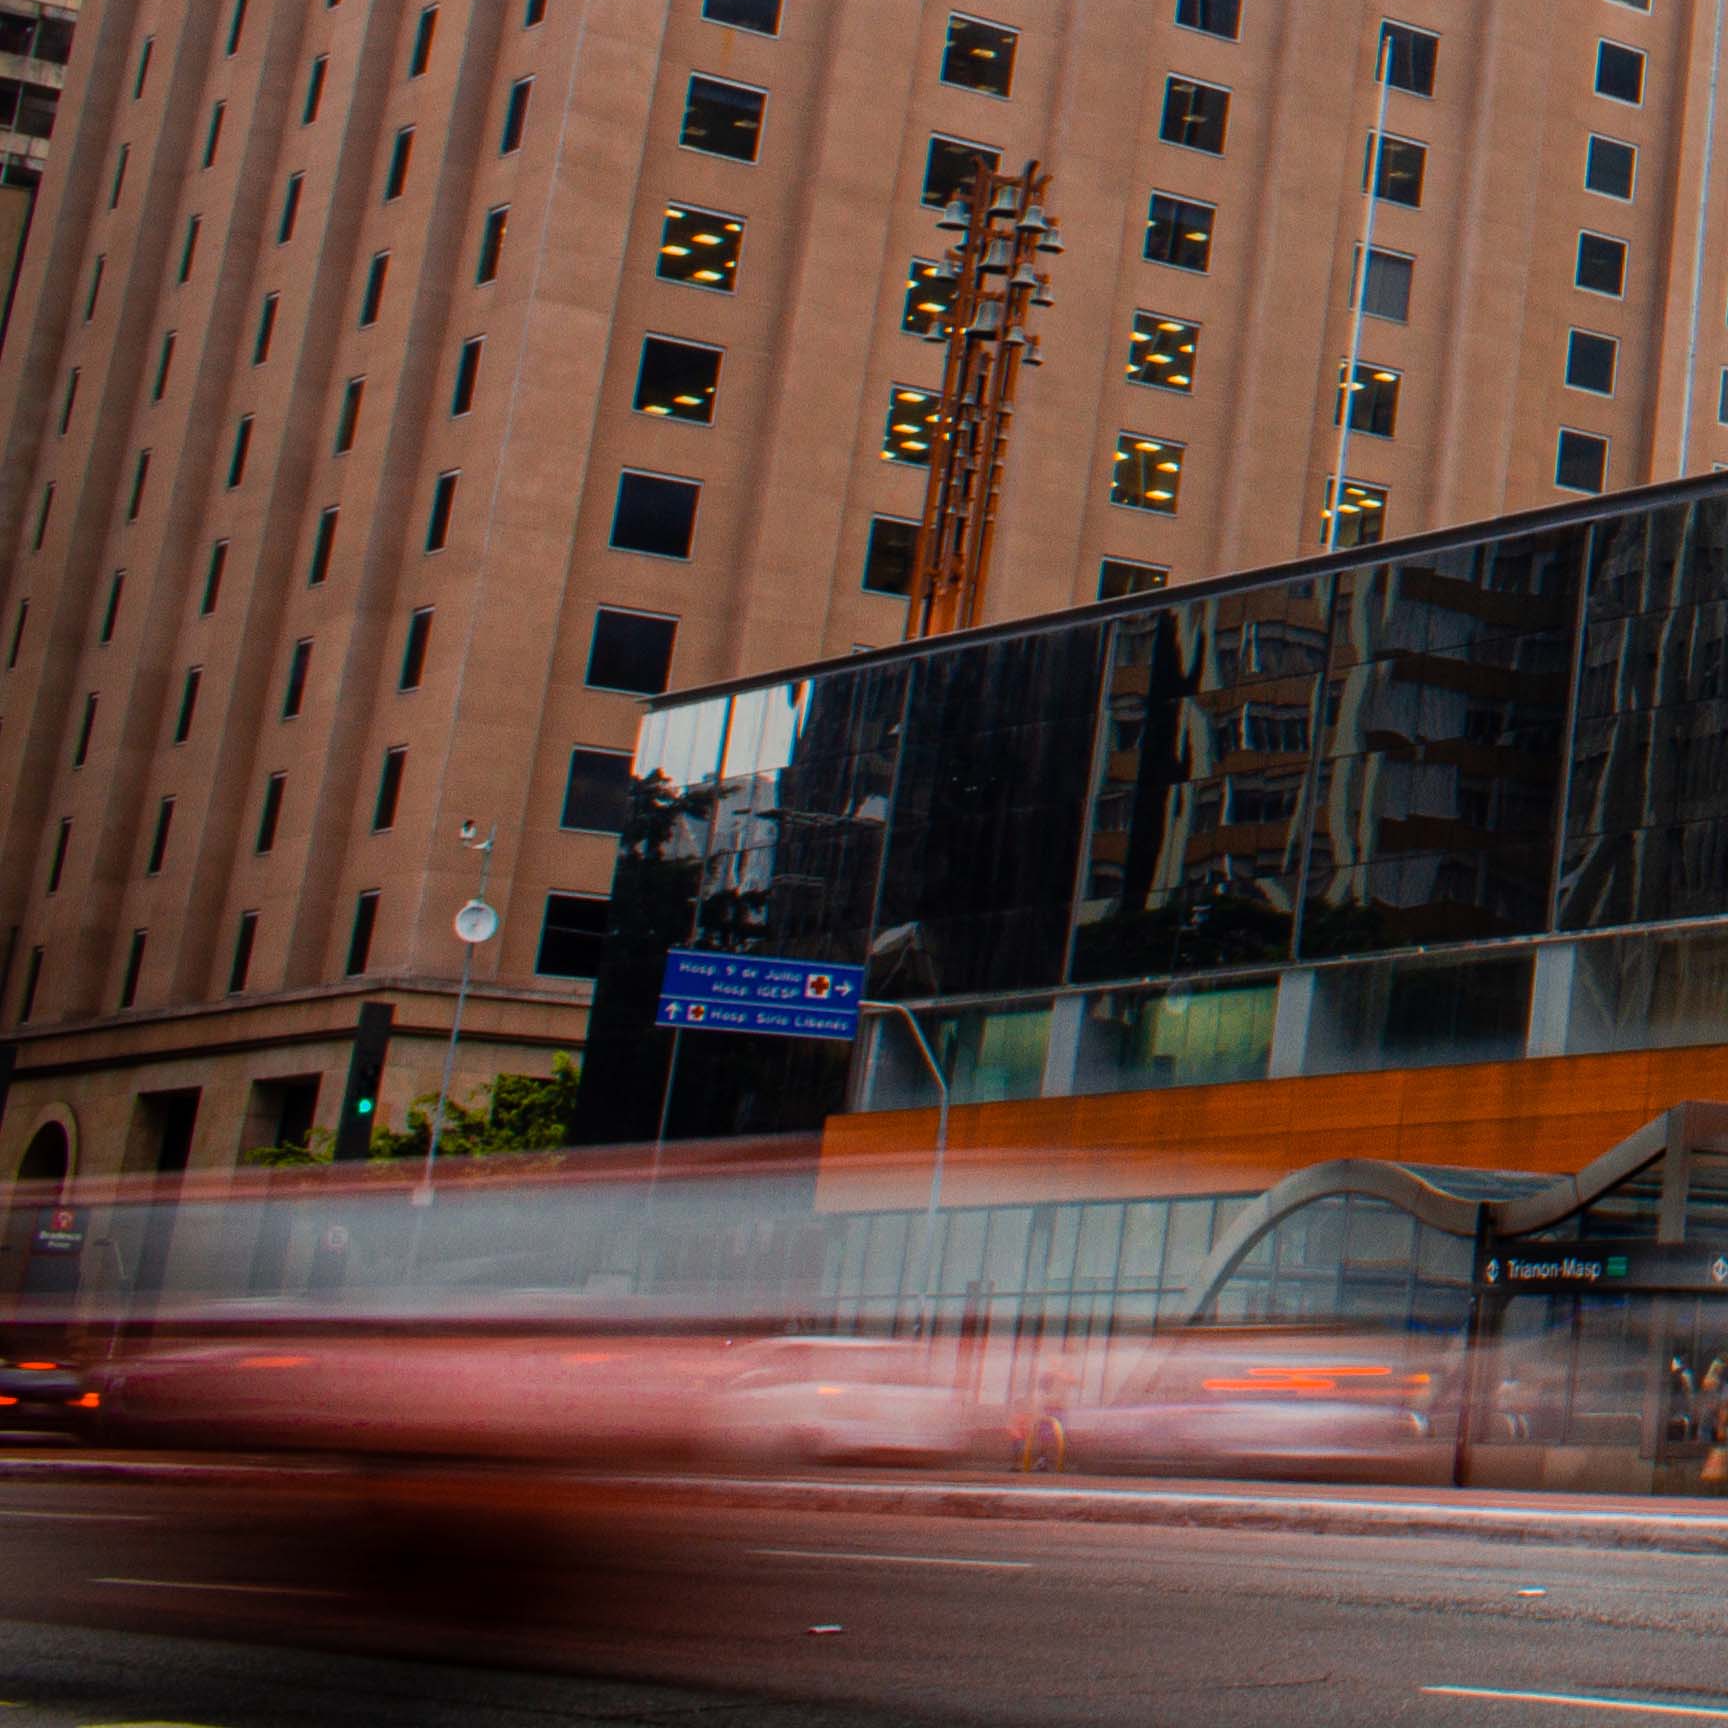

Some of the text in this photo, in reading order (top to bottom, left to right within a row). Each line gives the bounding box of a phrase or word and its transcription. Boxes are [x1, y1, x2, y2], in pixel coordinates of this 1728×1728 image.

[742, 968, 757, 978] de
[764, 970, 801, 982] Julho
[1507, 1257, 1601, 1283] Trianon-Masp
